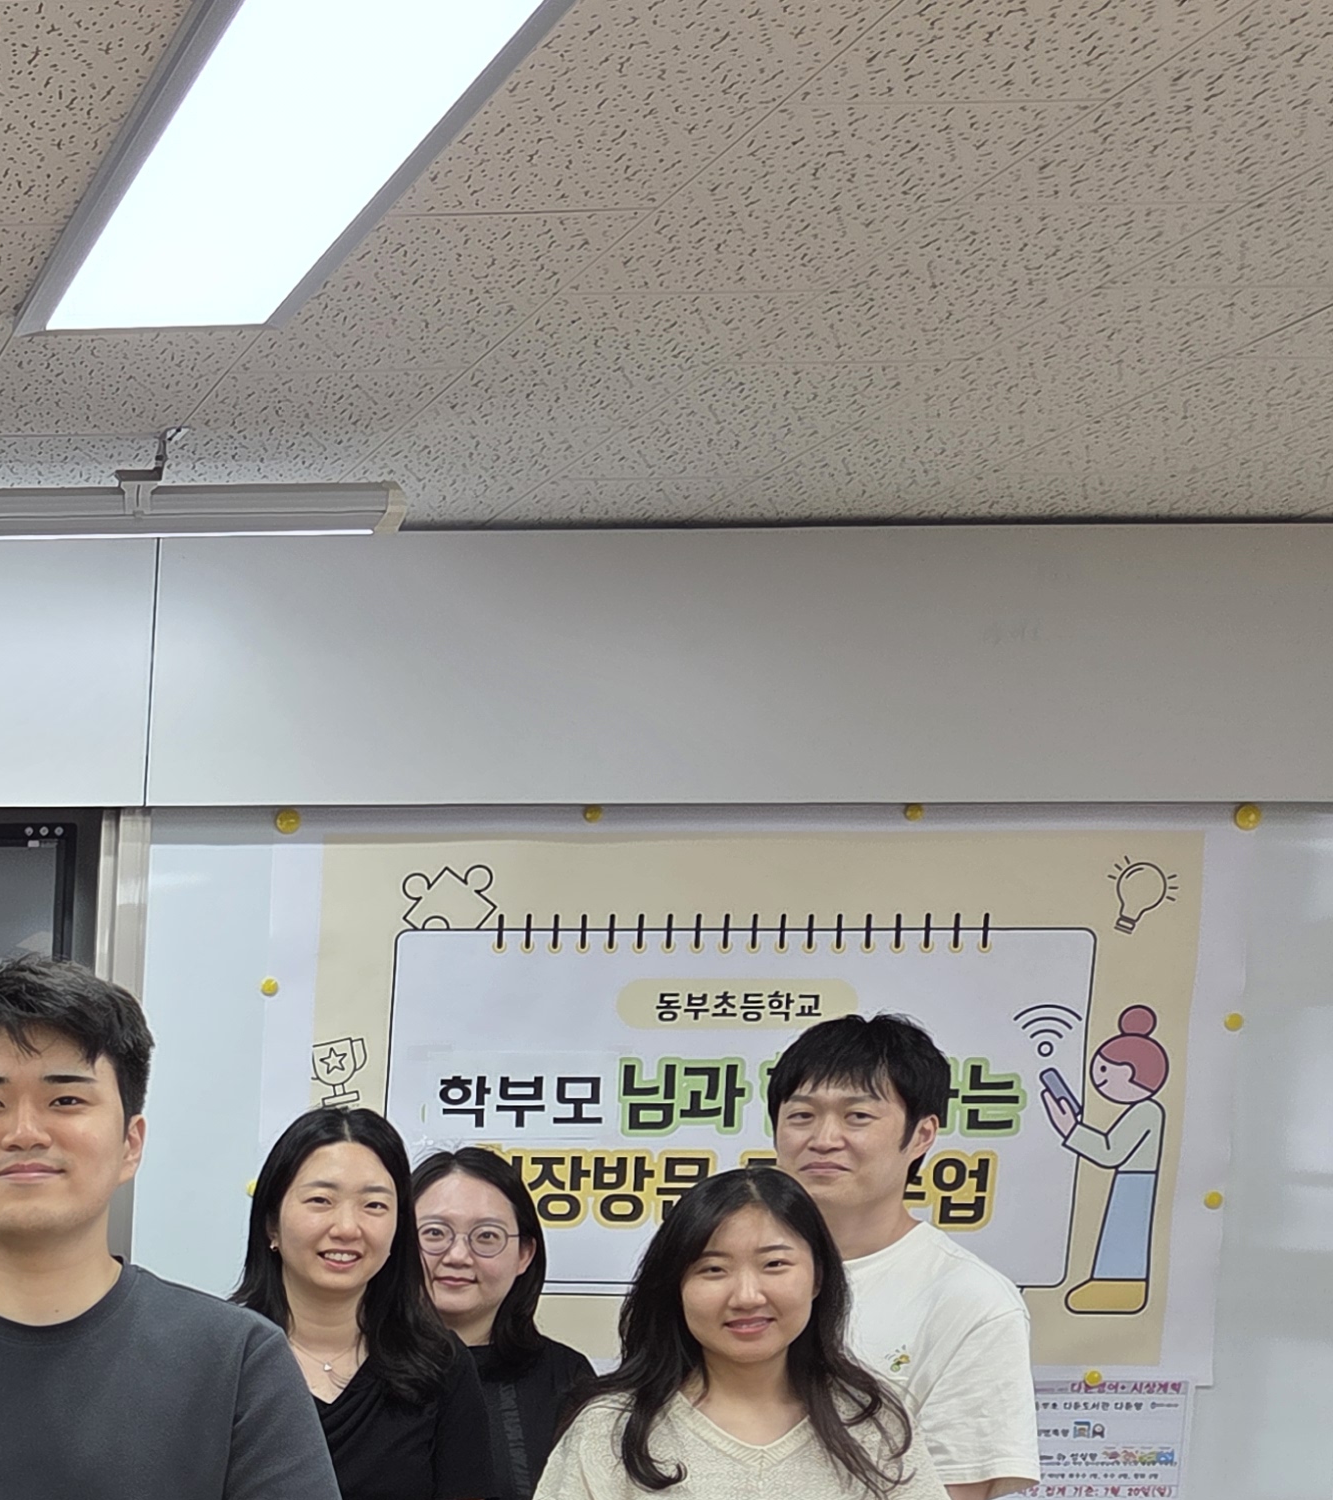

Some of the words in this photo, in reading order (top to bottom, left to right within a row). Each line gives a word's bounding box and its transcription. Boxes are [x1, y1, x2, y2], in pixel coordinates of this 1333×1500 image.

[656, 991, 822, 1022] 동부초등학교
[438, 1075, 604, 1128] 학부모
[622, 1064, 745, 1130] 님과
